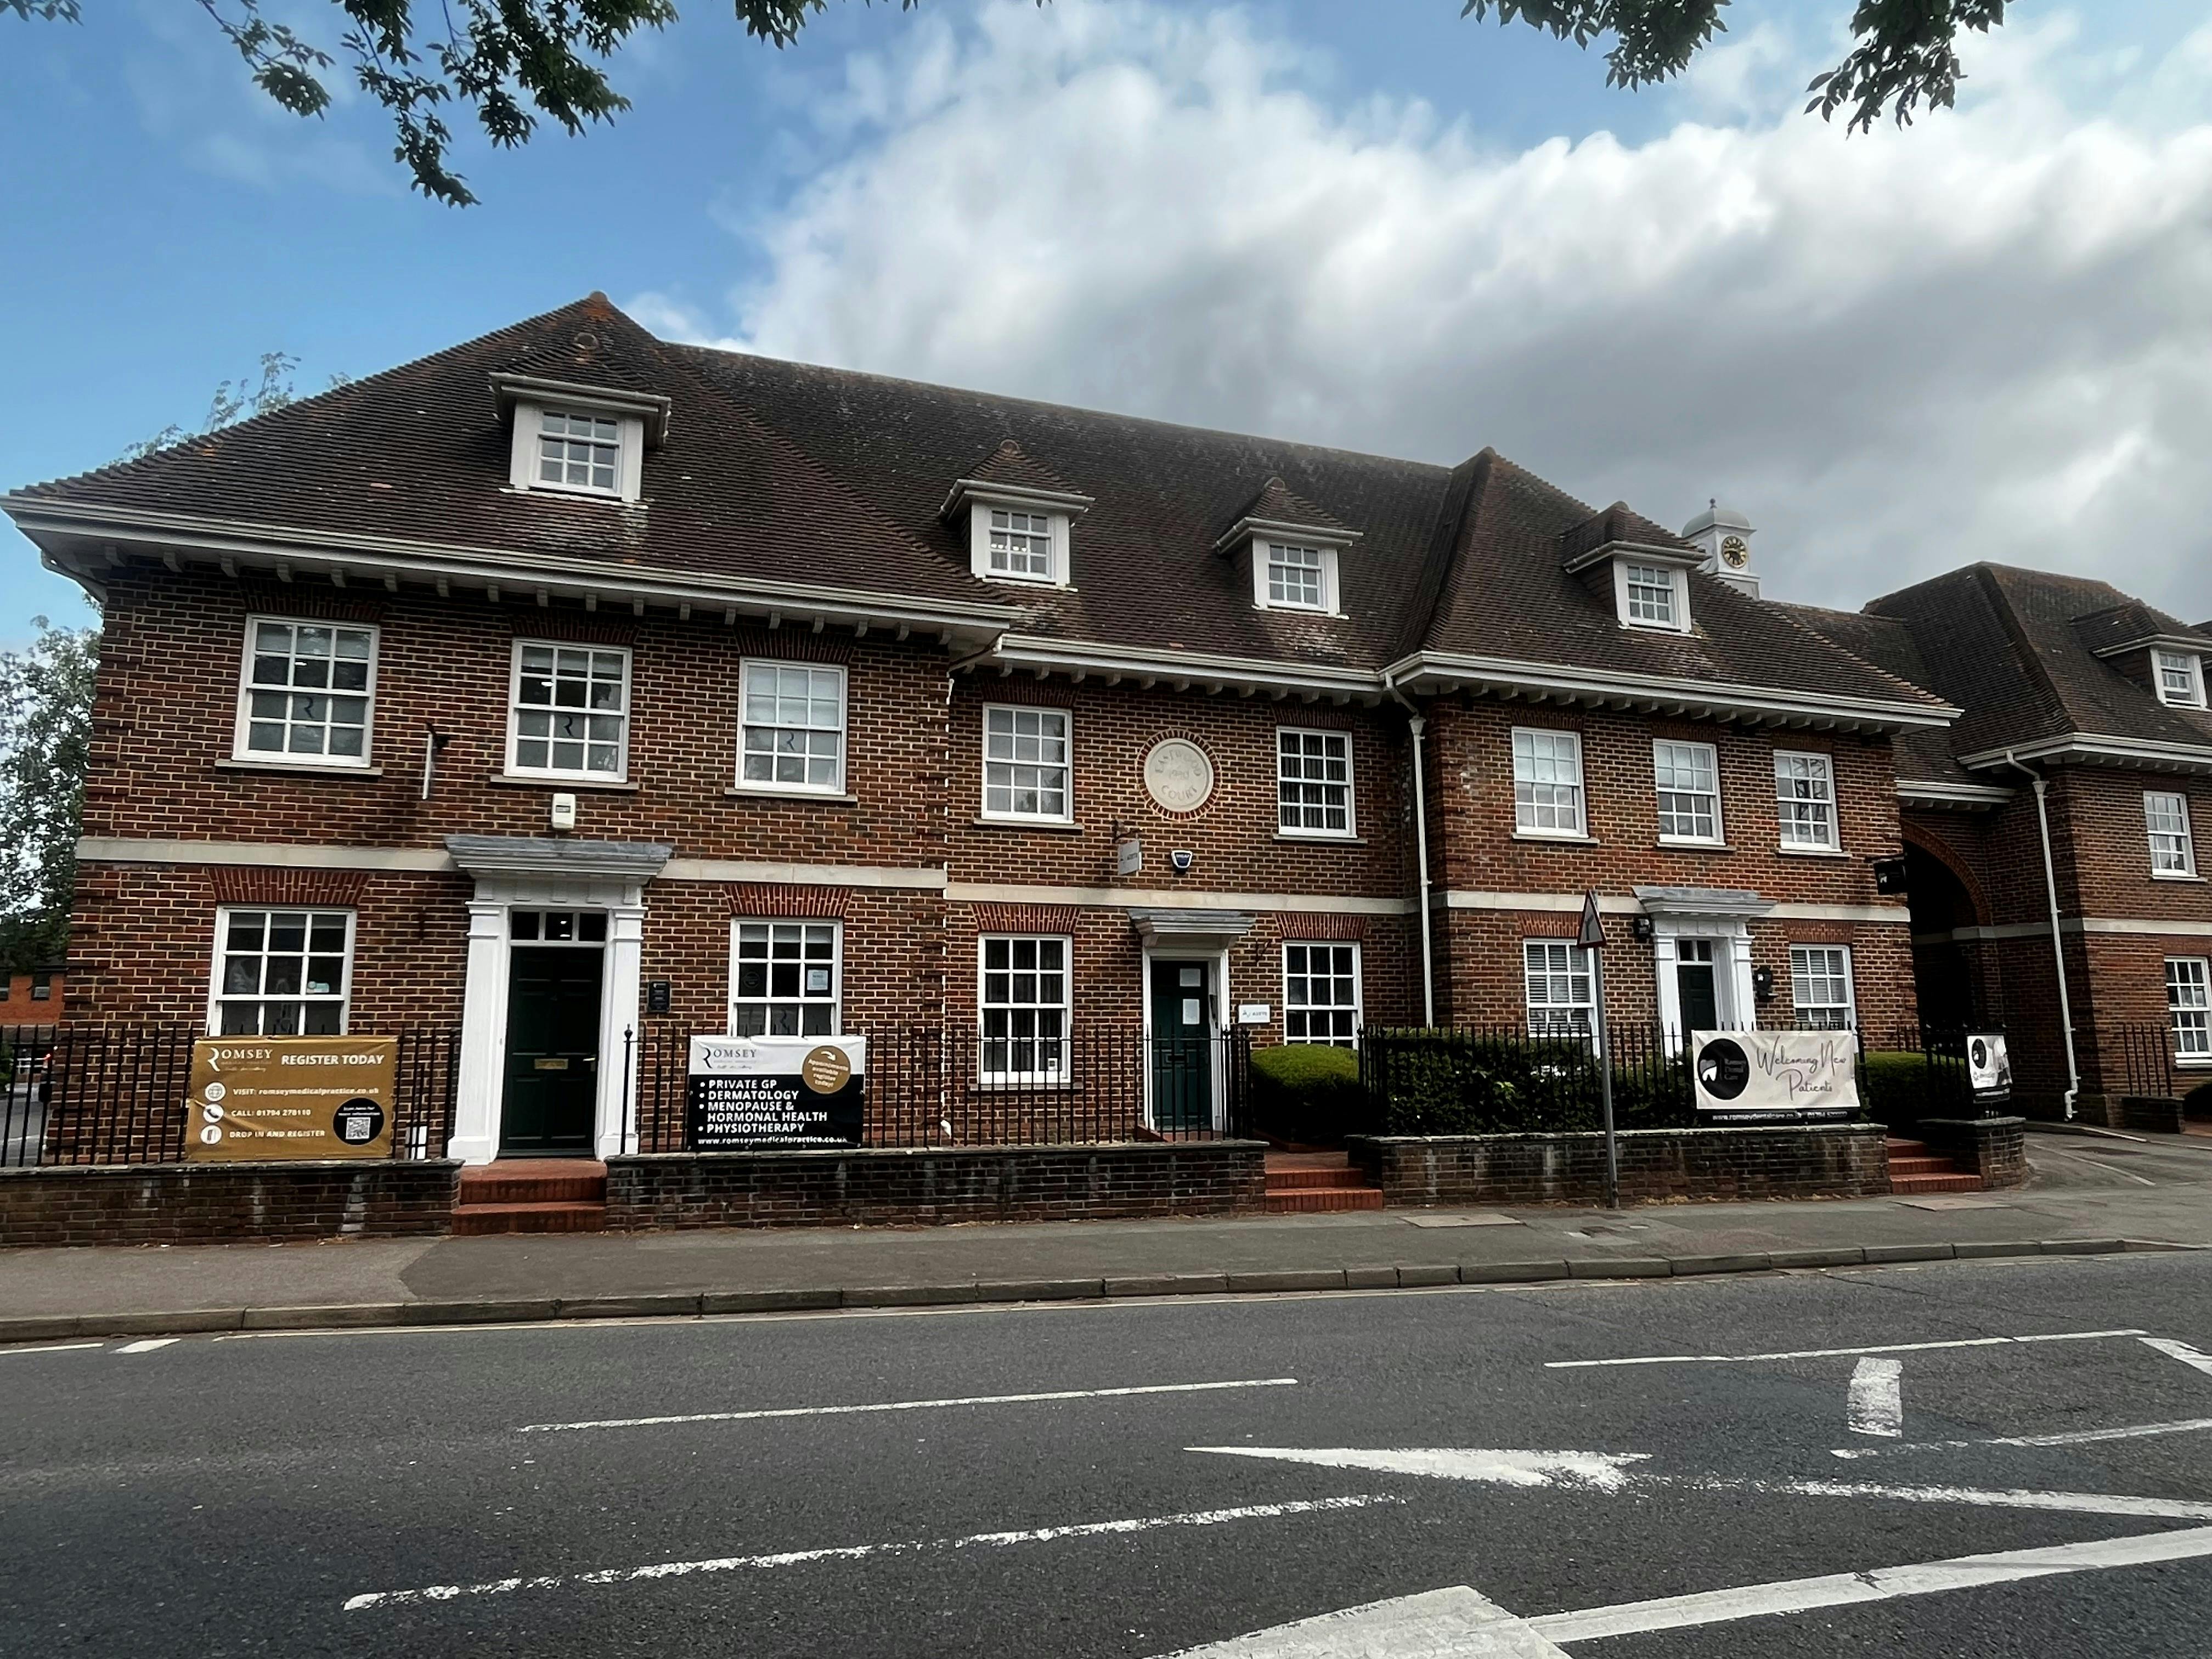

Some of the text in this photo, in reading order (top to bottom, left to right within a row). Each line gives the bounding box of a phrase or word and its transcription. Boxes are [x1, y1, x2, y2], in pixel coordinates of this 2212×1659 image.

[1161, 785, 1197, 800] COURT
[207, 1047, 273, 1072] ROMSEY
[281, 1054, 385, 1065] REGISTER TODAY
[703, 1047, 757, 1069] ROMSEY
[1757, 1035, 1819, 1076] Welcoming
[1820, 1040, 1847, 1076] New
[709, 1079, 777, 1089] PRIVATE GP
[1775, 1068, 1833, 1101] Patients
[708, 1090, 799, 1101] DERMATOLOGY
[708, 1101, 794, 1111] MENOPAUSE &
[707, 1111, 827, 1122] HORMONAL HEALTH
[707, 1123, 804, 1133] PHYSIOTHERAPY
